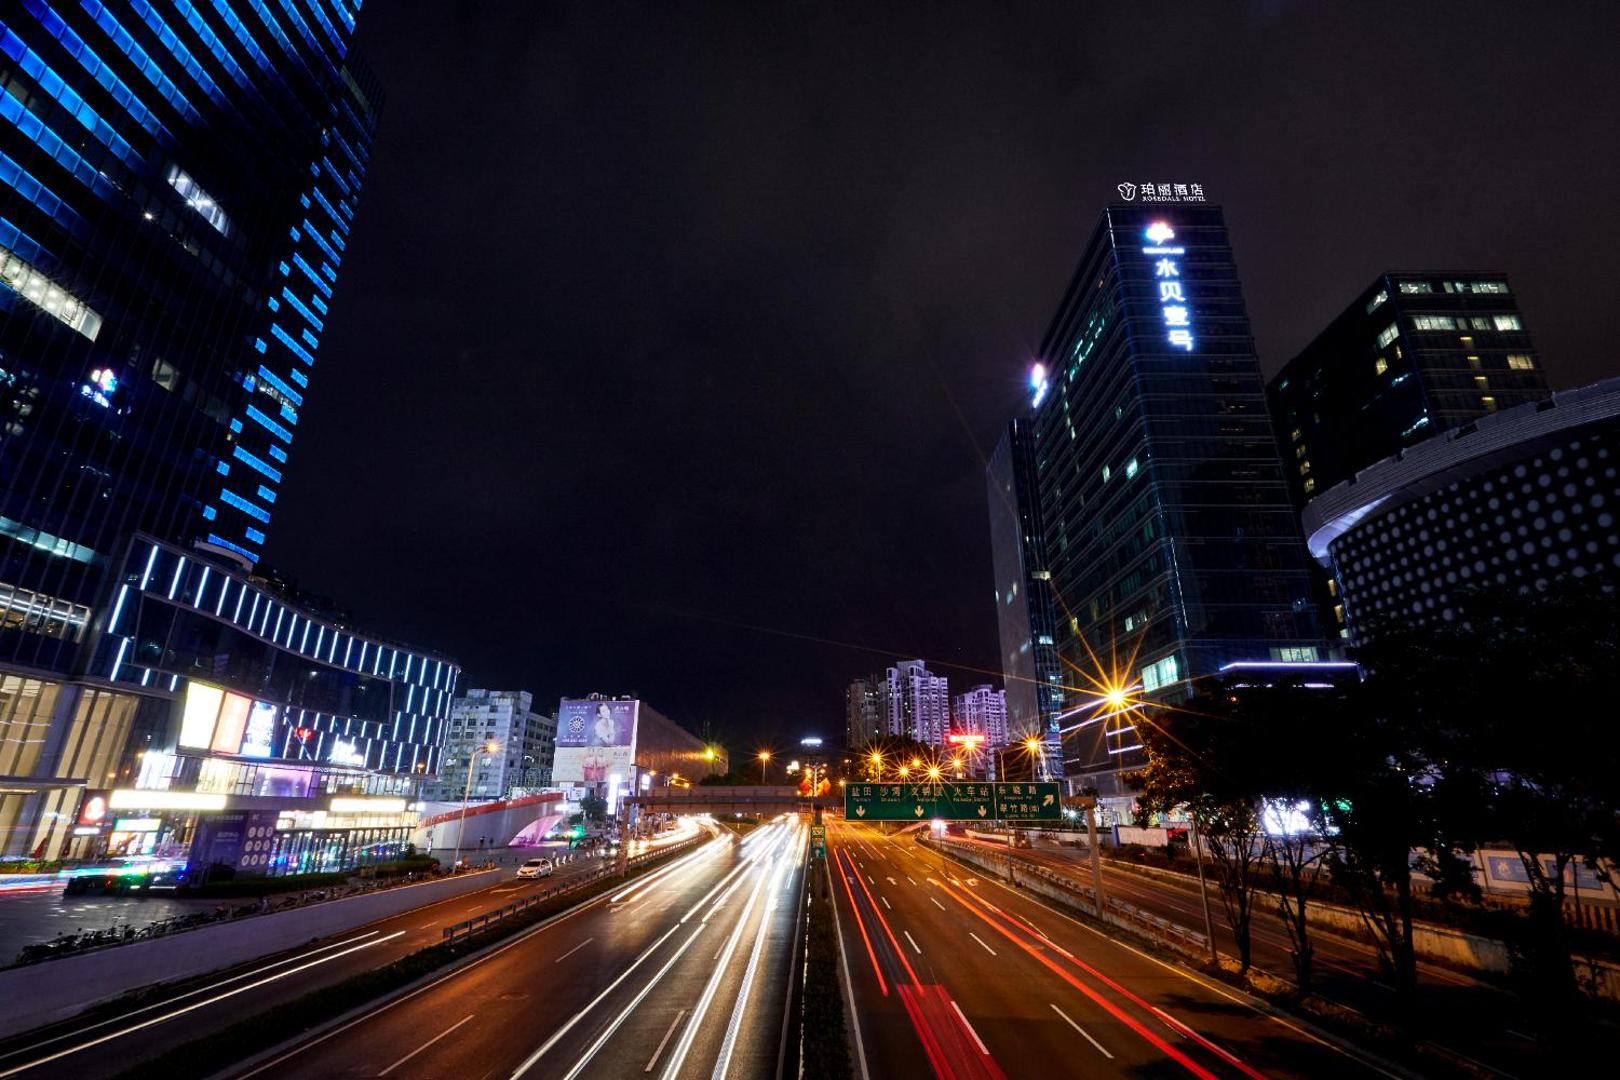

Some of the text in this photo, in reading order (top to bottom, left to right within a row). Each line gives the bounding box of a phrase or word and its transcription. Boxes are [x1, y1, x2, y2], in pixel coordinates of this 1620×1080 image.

[1140, 182, 1204, 196] 珀丽酒店
[1155, 257, 1193, 352] 水贝壹号
[953, 786, 989, 797] 火车站
